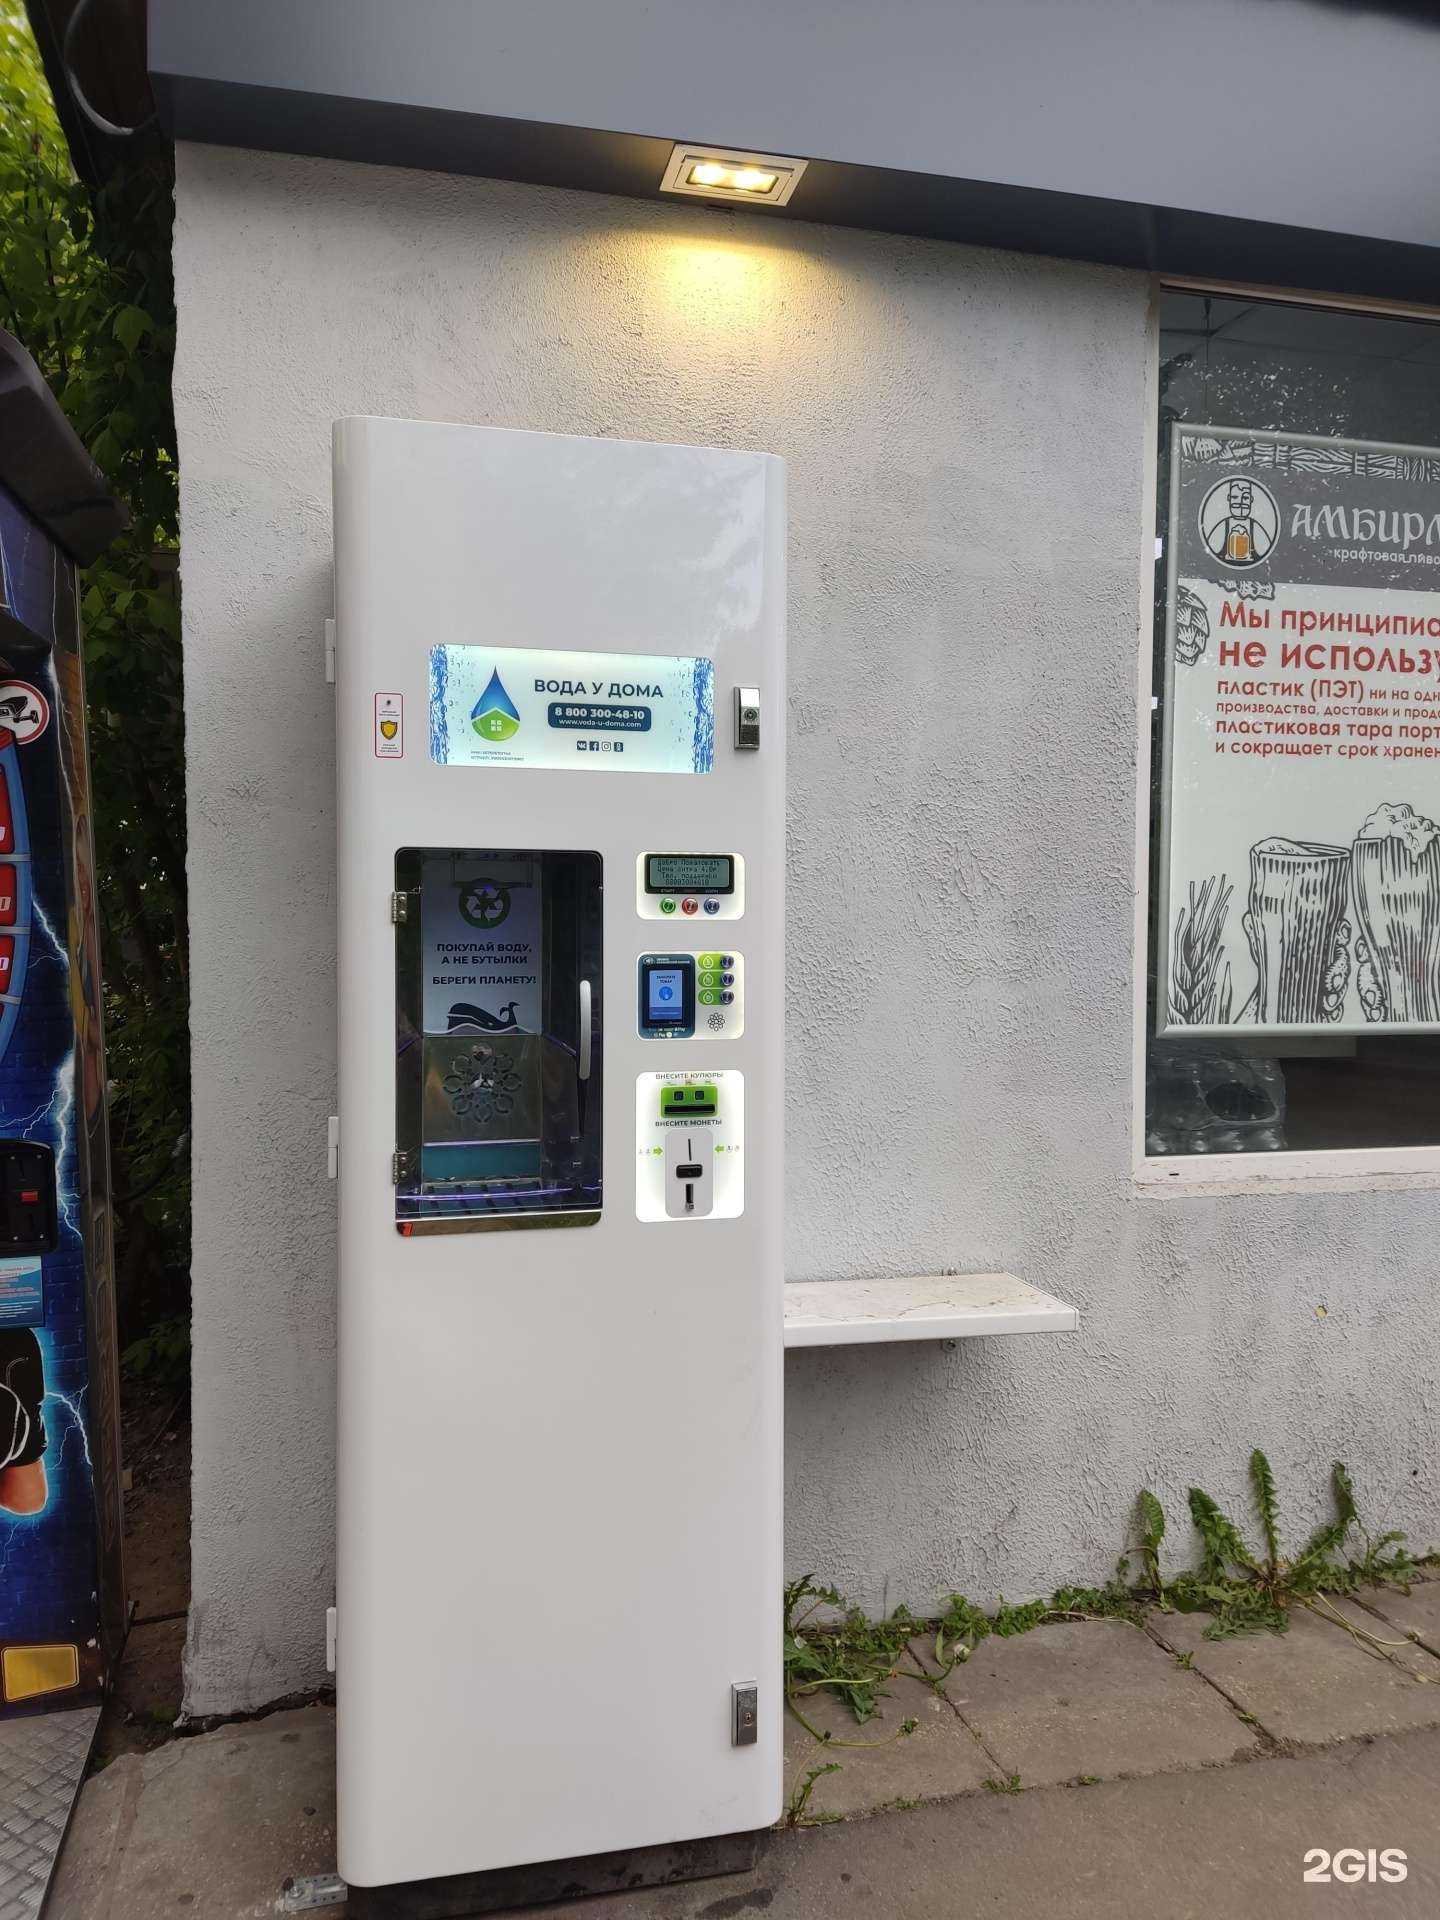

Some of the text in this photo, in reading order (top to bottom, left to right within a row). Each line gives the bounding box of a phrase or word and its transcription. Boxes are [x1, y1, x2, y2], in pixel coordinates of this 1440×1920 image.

[1219, 601, 1269, 628] Мы
[1219, 641, 1266, 668] не
[534, 679, 664, 698] ВОДА У ДОМА
[1217, 680, 1304, 696] пластик
[1310, 679, 1364, 703] (ПЭТ)
[1369, 689, 1387, 699] ни
[1391, 690, 1409, 700] на
[555, 707, 645, 719] 8 800 300-48-10
[1324, 706, 1388, 717] доставки
[1392, 708, 1400, 717] и
[1404, 708, 1440, 719] прод
[559, 719, 642, 728] www.voda-u-doma.com
[1216, 720, 1340, 736] пластиковая
[1346, 723, 1393, 740] тара
[1215, 742, 1225, 753] и
[1231, 742, 1332, 757] сокращает
[1338, 745, 1378, 759] срок
[437, 941, 532, 953] ПОКУПАЙ ВОДУ,
[441, 955, 528, 964] А НЕ БУТЫЛКИ
[432, 975, 537, 985] БЕРЕГИ ПЛАНЕТУ!
